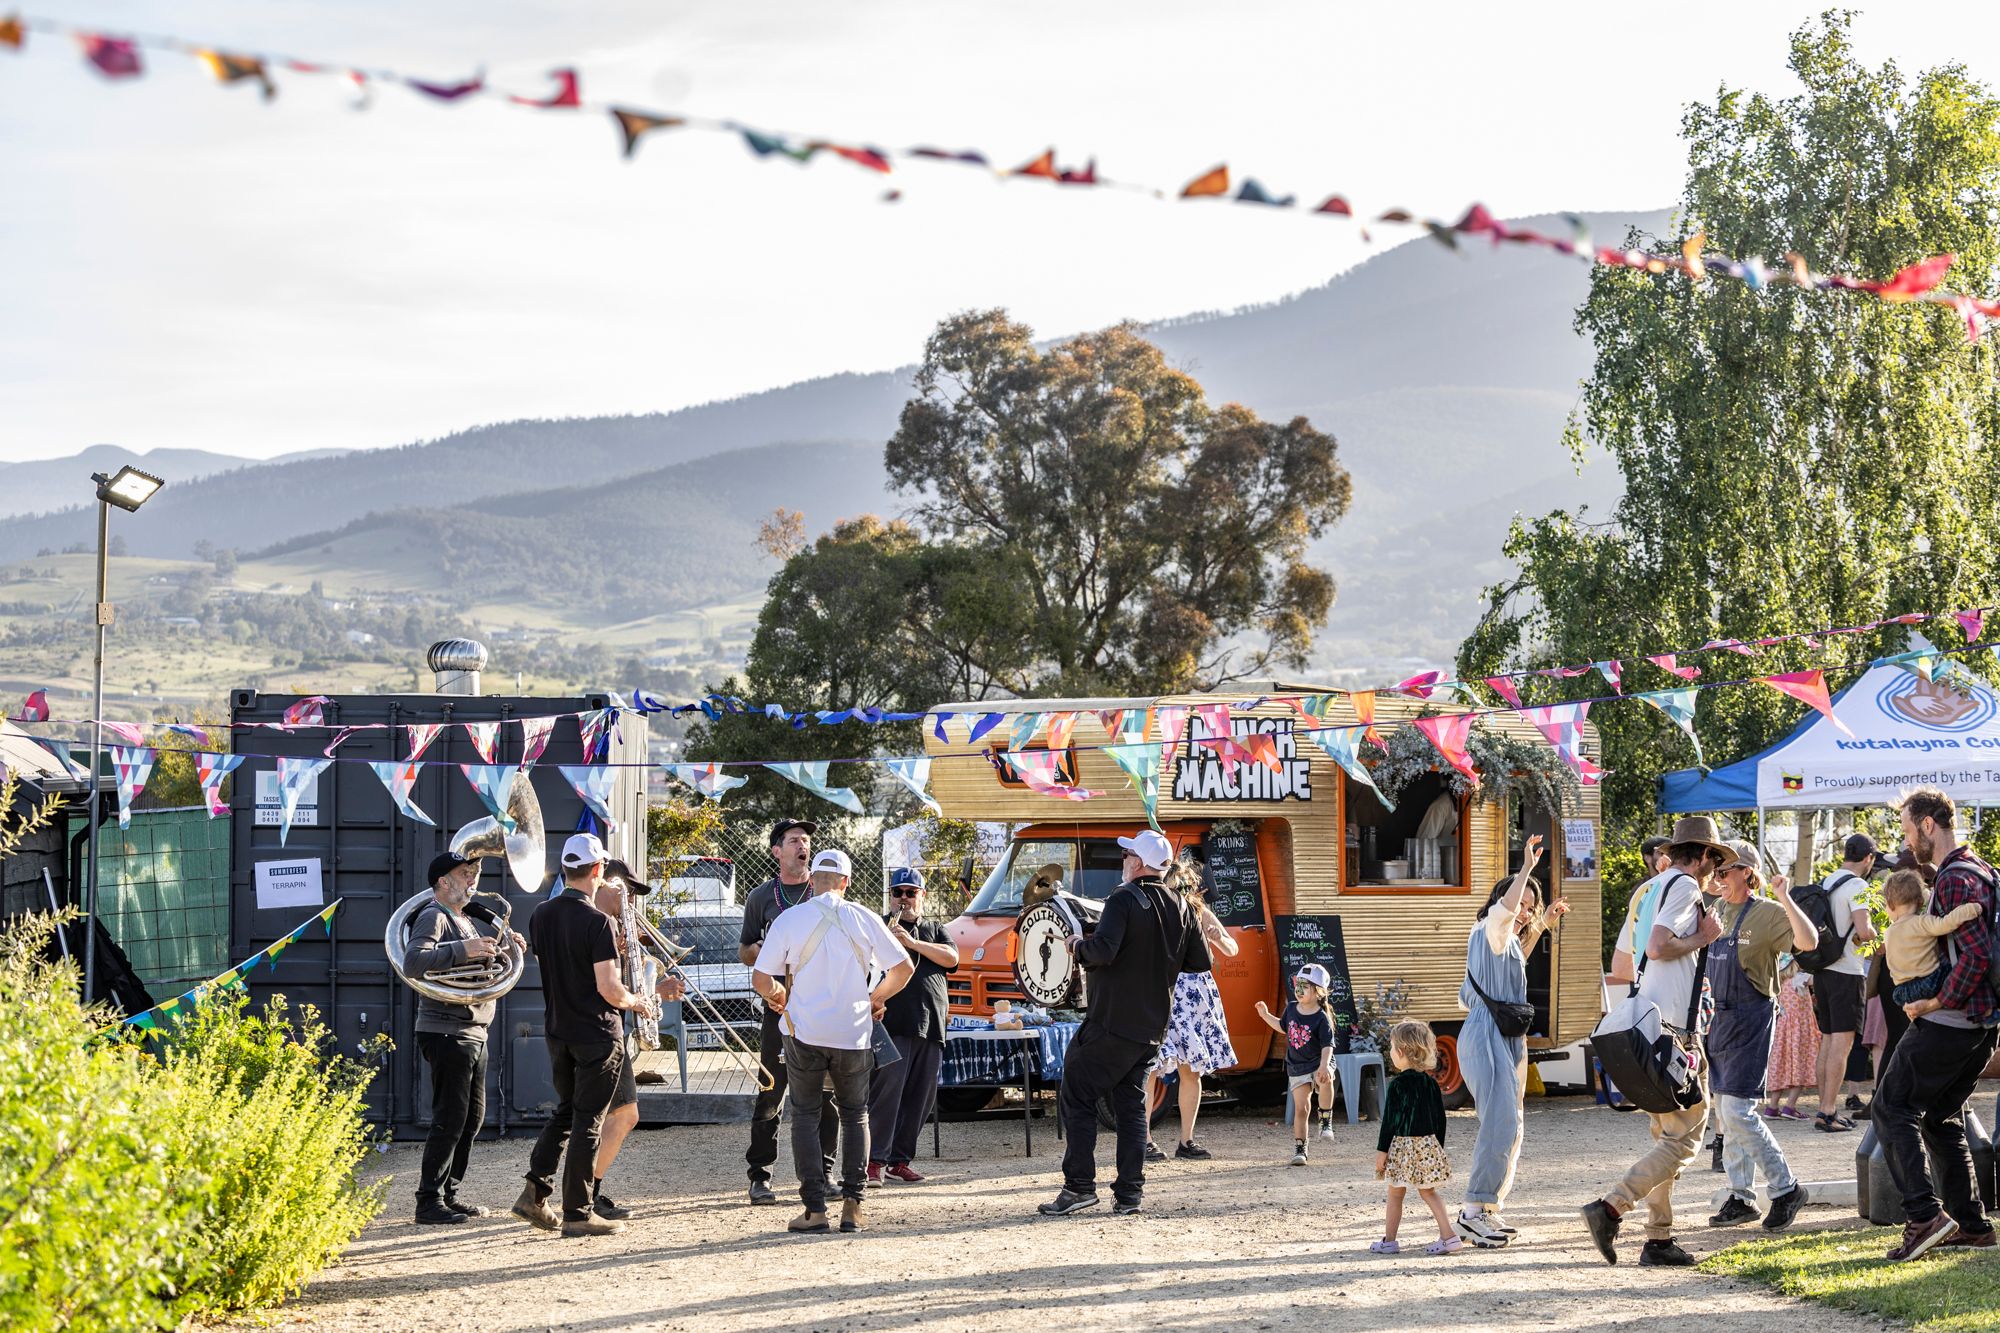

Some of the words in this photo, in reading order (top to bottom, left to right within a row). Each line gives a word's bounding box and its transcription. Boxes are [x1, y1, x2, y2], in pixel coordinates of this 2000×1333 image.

[1836, 738, 1960, 752] kutalayna
[1176, 759, 1311, 799] MACHINE
[1815, 776, 1865, 788] Proudly
[1869, 771, 1937, 786] supported
[1941, 771, 1956, 785] by
[1960, 771, 1981, 783] the
[1218, 837, 1244, 848] DRINKS
[1022, 910, 1070, 938] SOUTHSID
[1296, 922, 1318, 931] MUNCH
[1293, 930, 1324, 939] MACHINE
[1020, 963, 1070, 1000] STEPPERS
